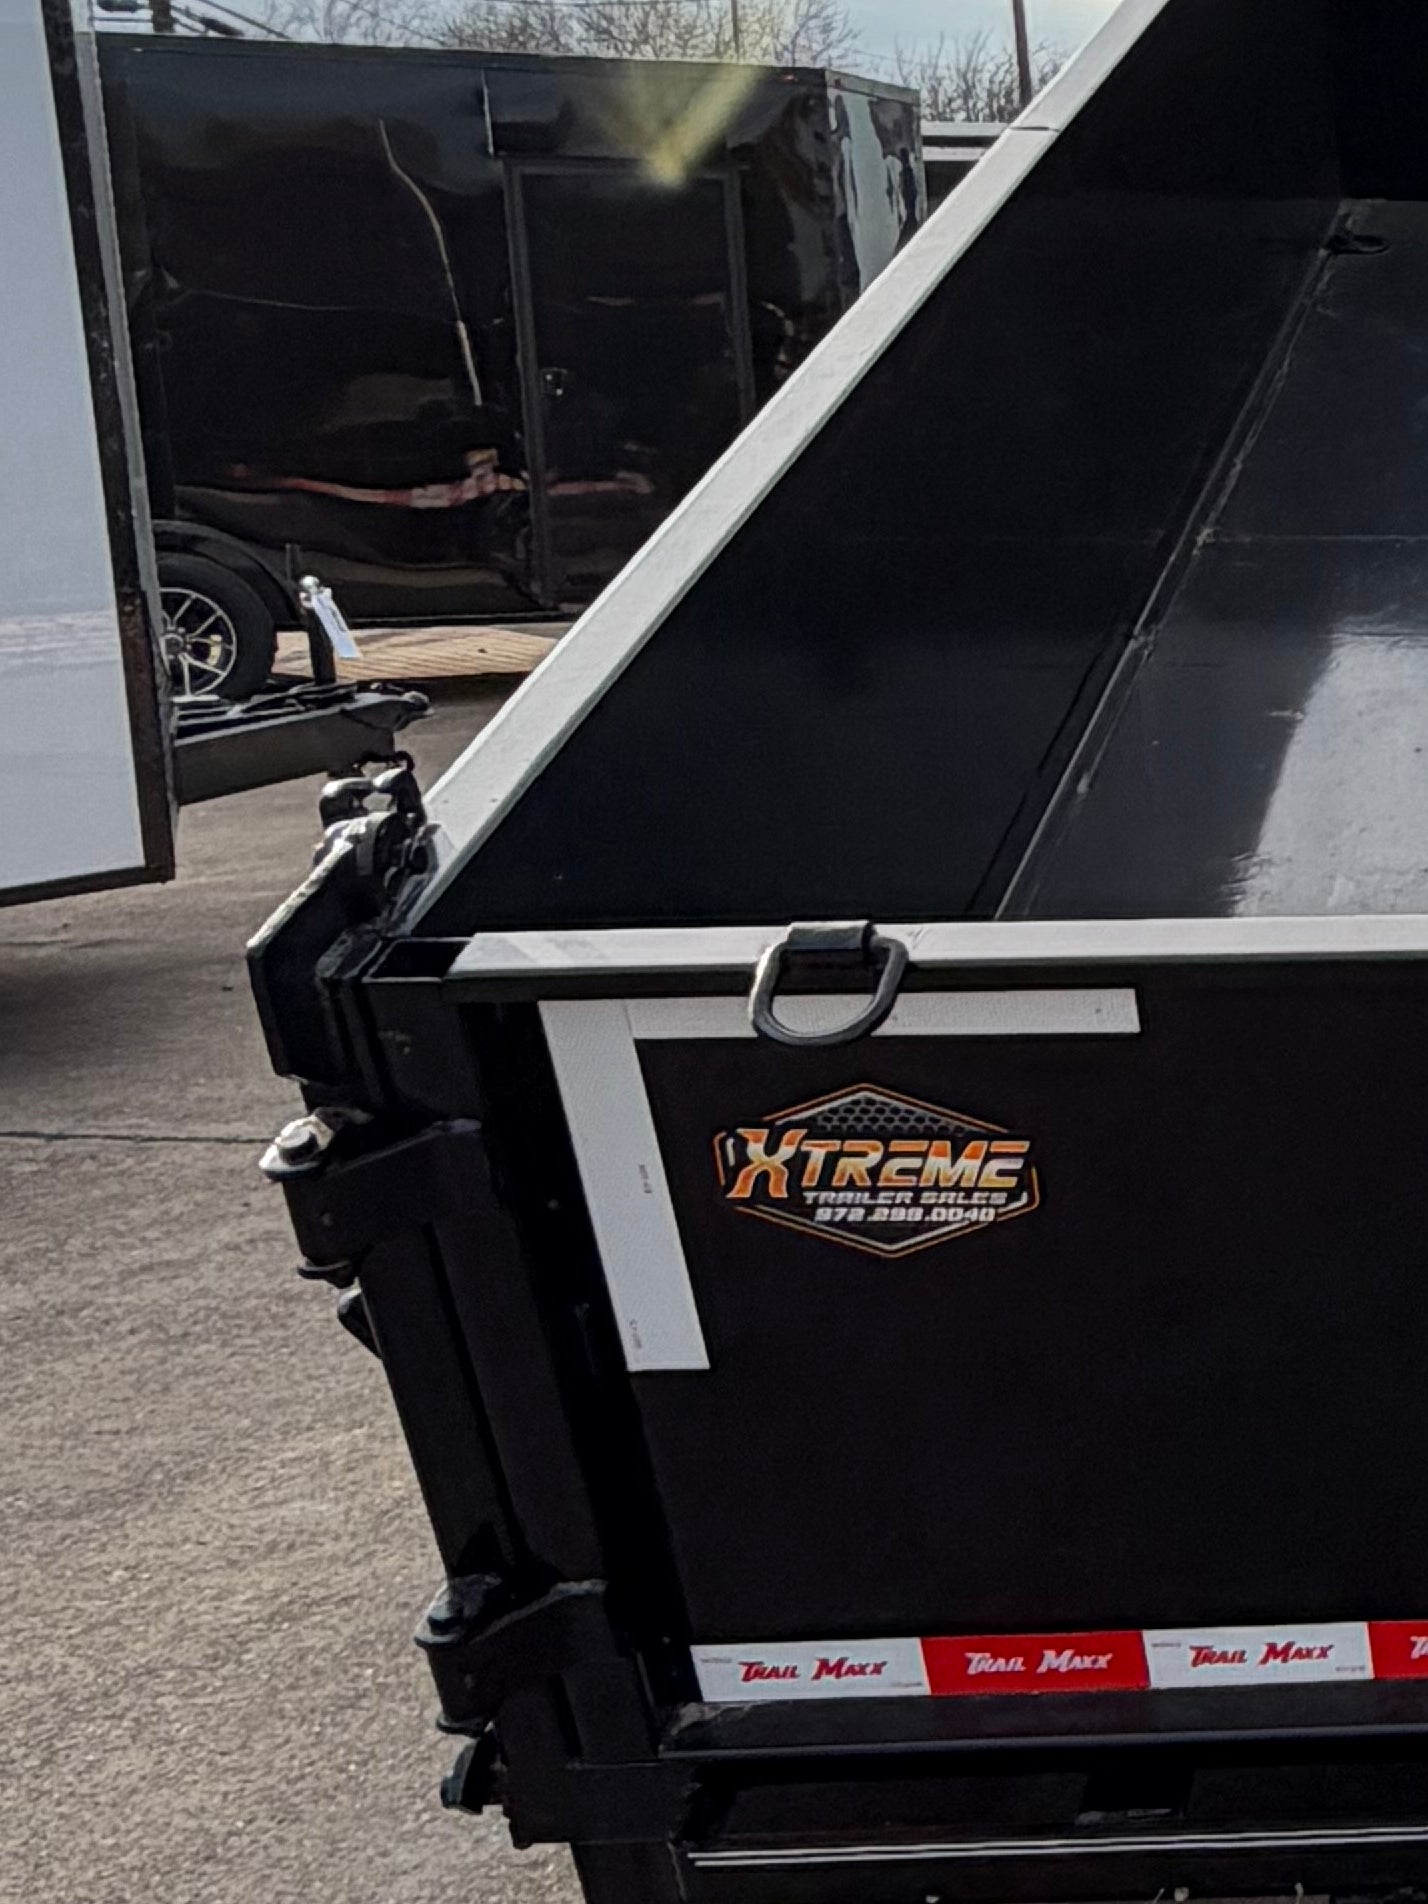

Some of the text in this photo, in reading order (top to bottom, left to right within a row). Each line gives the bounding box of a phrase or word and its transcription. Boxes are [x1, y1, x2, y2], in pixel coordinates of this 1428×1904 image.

[726, 1128, 1030, 1198] XTREME
[803, 1191, 1007, 1204] TRAILER SALES
